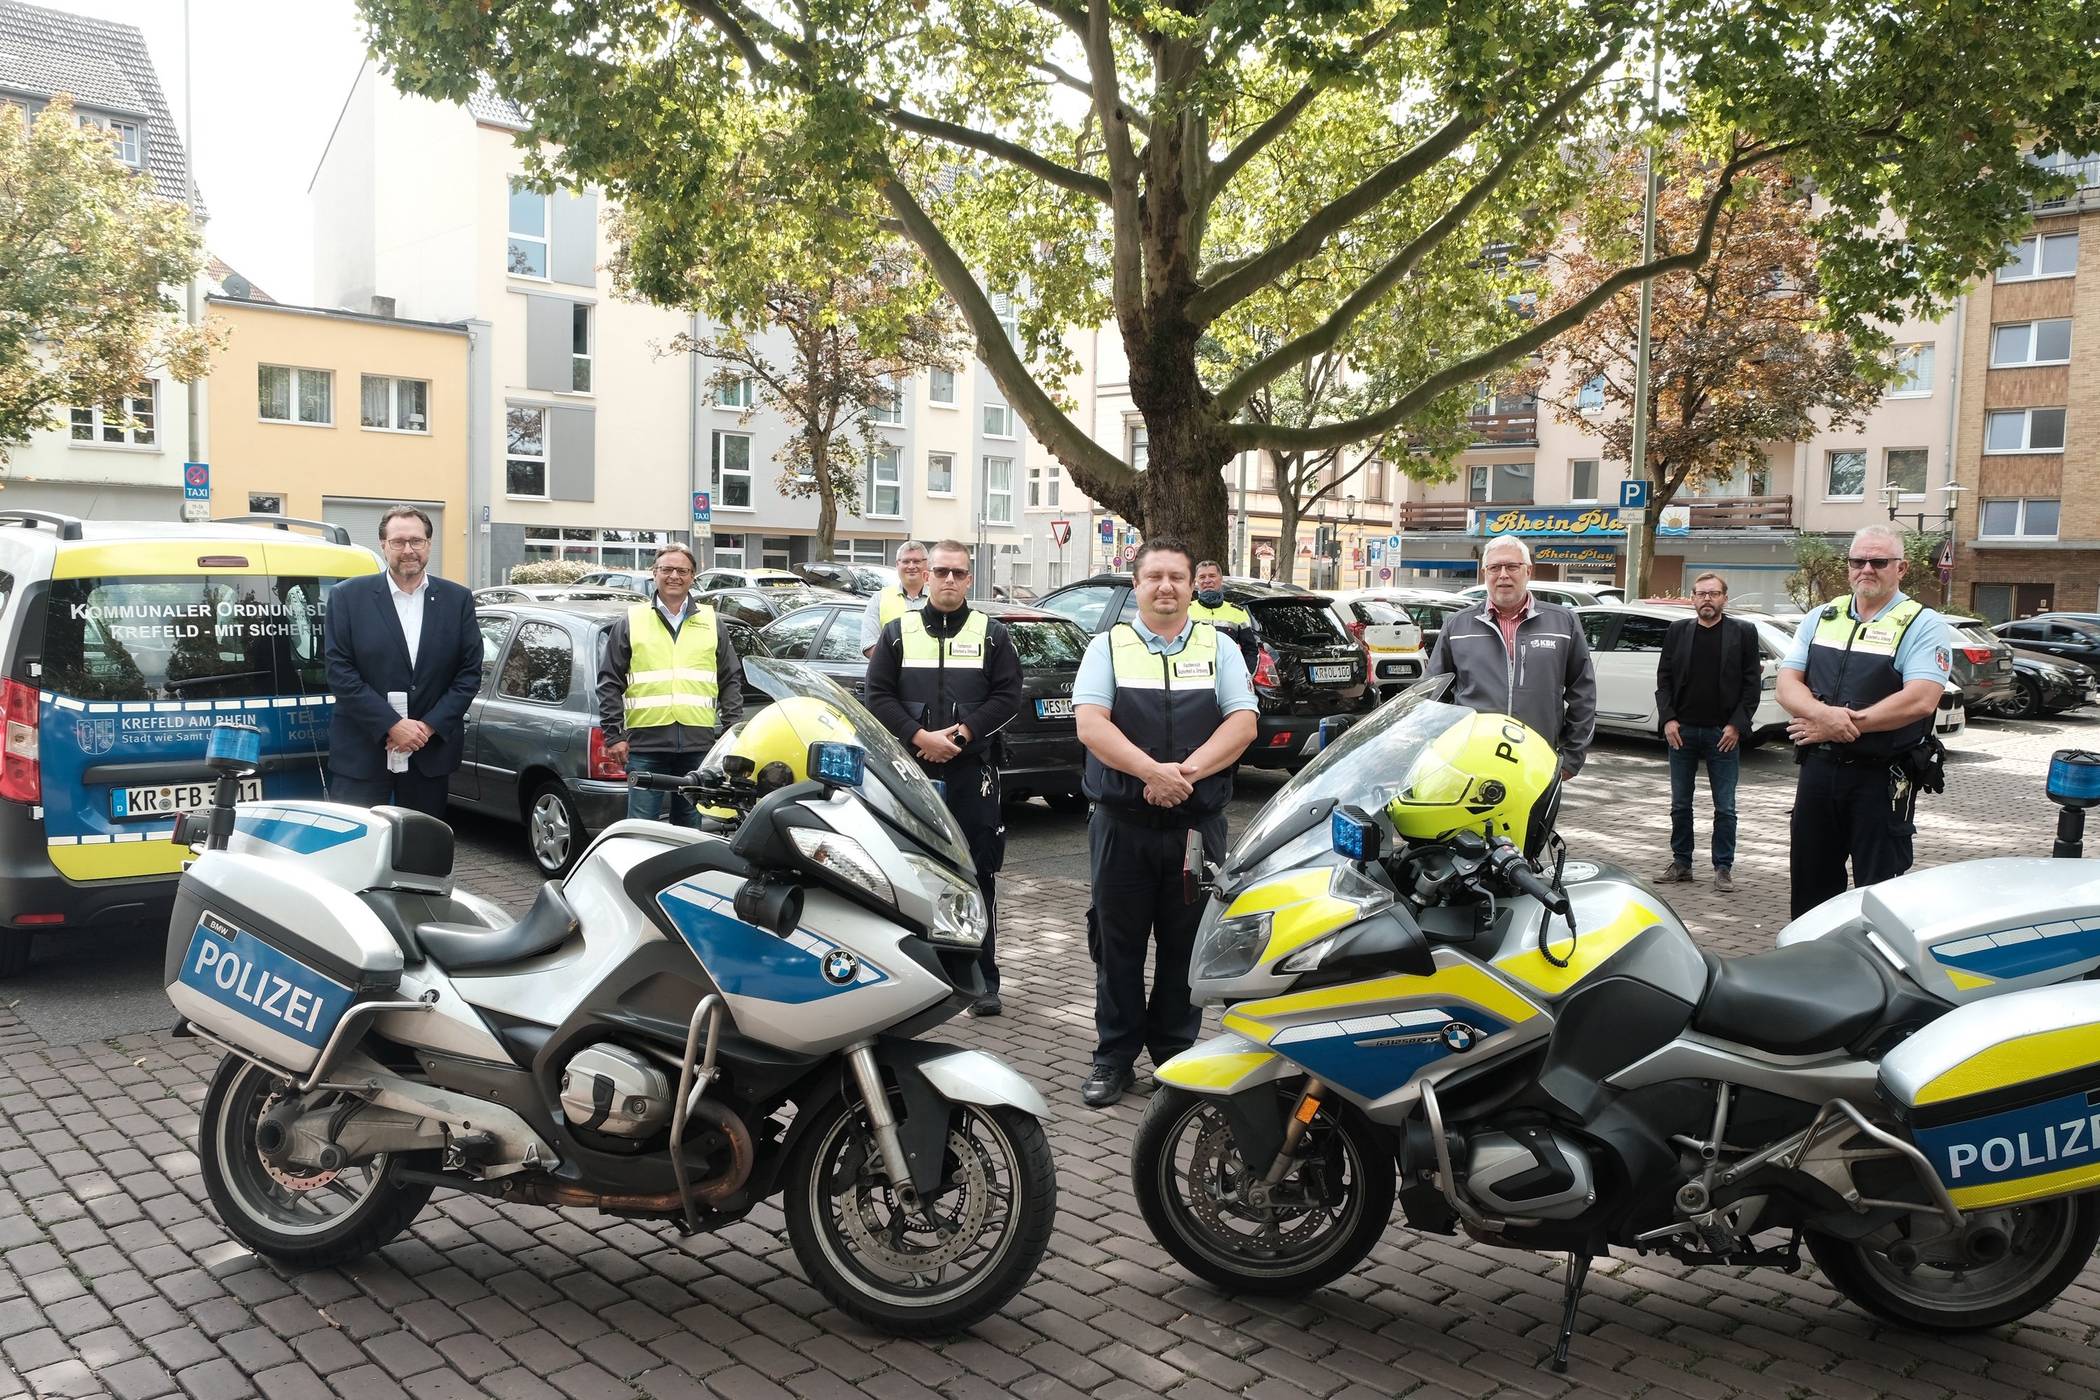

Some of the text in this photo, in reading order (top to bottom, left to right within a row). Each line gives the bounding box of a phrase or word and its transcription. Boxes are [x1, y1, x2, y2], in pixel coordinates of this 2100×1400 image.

[187, 488, 208, 497] TAXI
[1625, 483, 1641, 505] P
[694, 512, 710, 520] TAXI
[1490, 509, 1626, 533] RheinPla
[1536, 547, 1614, 562] RheinPlay
[71, 602, 327, 619] KOMMUNALER ORDNUNSD
[111, 625, 199, 639] KREFELD
[214, 624, 243, 637] MIT
[250, 623, 325, 637] SICHERH
[1043, 700, 1061, 714] WES
[122, 717, 184, 730] KREFELD
[188, 715, 211, 727] AM
[122, 733, 151, 744] Stadt
[153, 733, 173, 743] wie
[176, 732, 202, 742] Samt
[128, 782, 259, 812] KR FB 311
[210, 920, 229, 936] BMW
[194, 939, 324, 1033] POLIZEI
